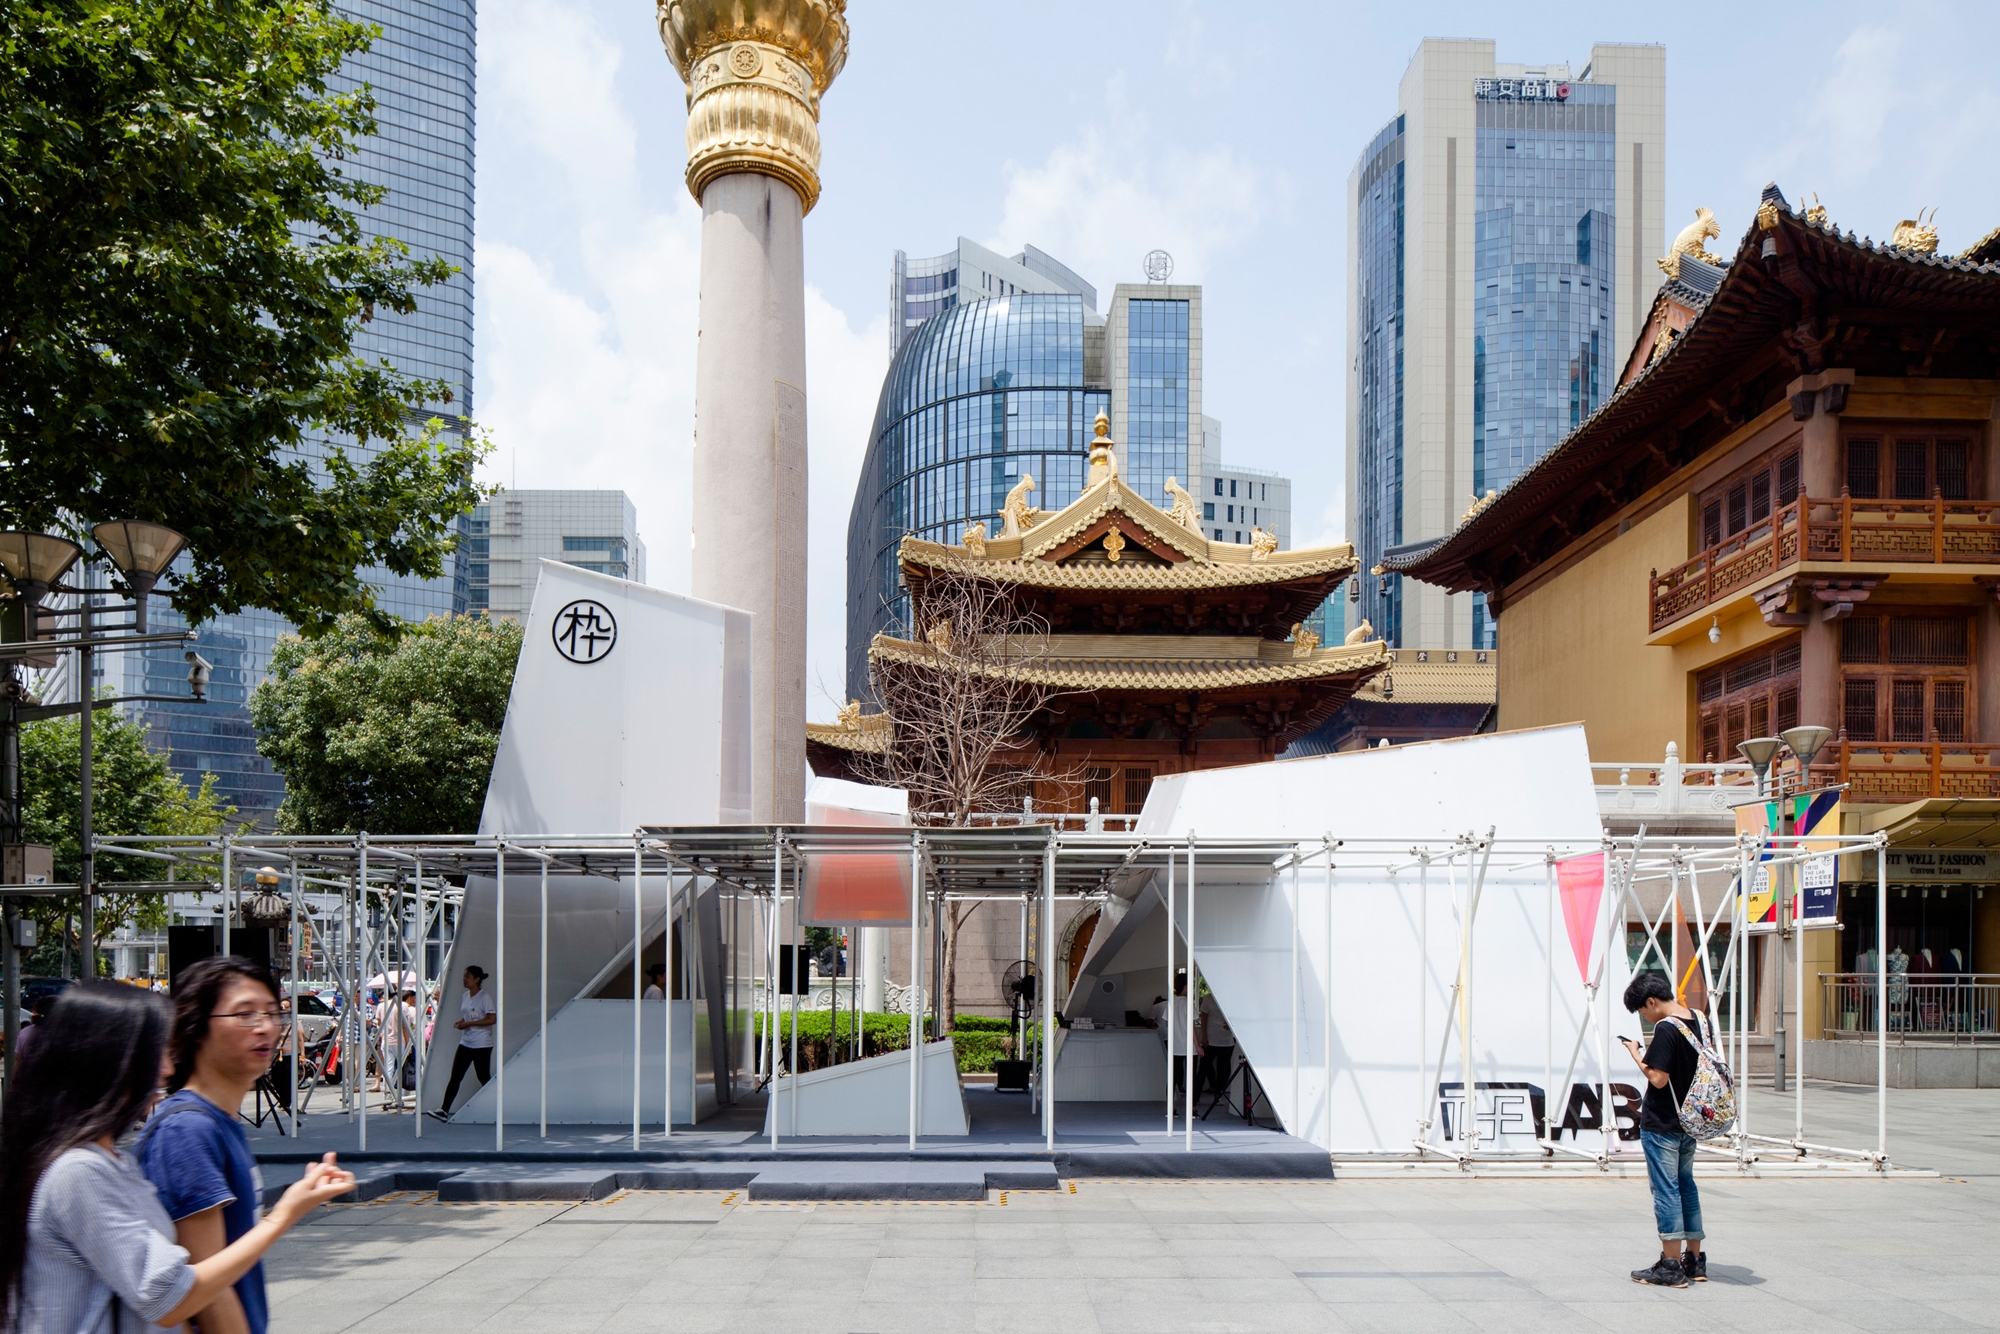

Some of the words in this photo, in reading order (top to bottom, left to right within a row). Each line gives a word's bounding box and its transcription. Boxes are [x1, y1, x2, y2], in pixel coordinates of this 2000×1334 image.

[1886, 854, 1903, 865] FIT
[1906, 854, 1936, 865] WELL
[1939, 854, 1987, 866] FASHION
[1938, 867, 1962, 875] TAILOR
[1527, 1082, 1642, 1141] LAB
